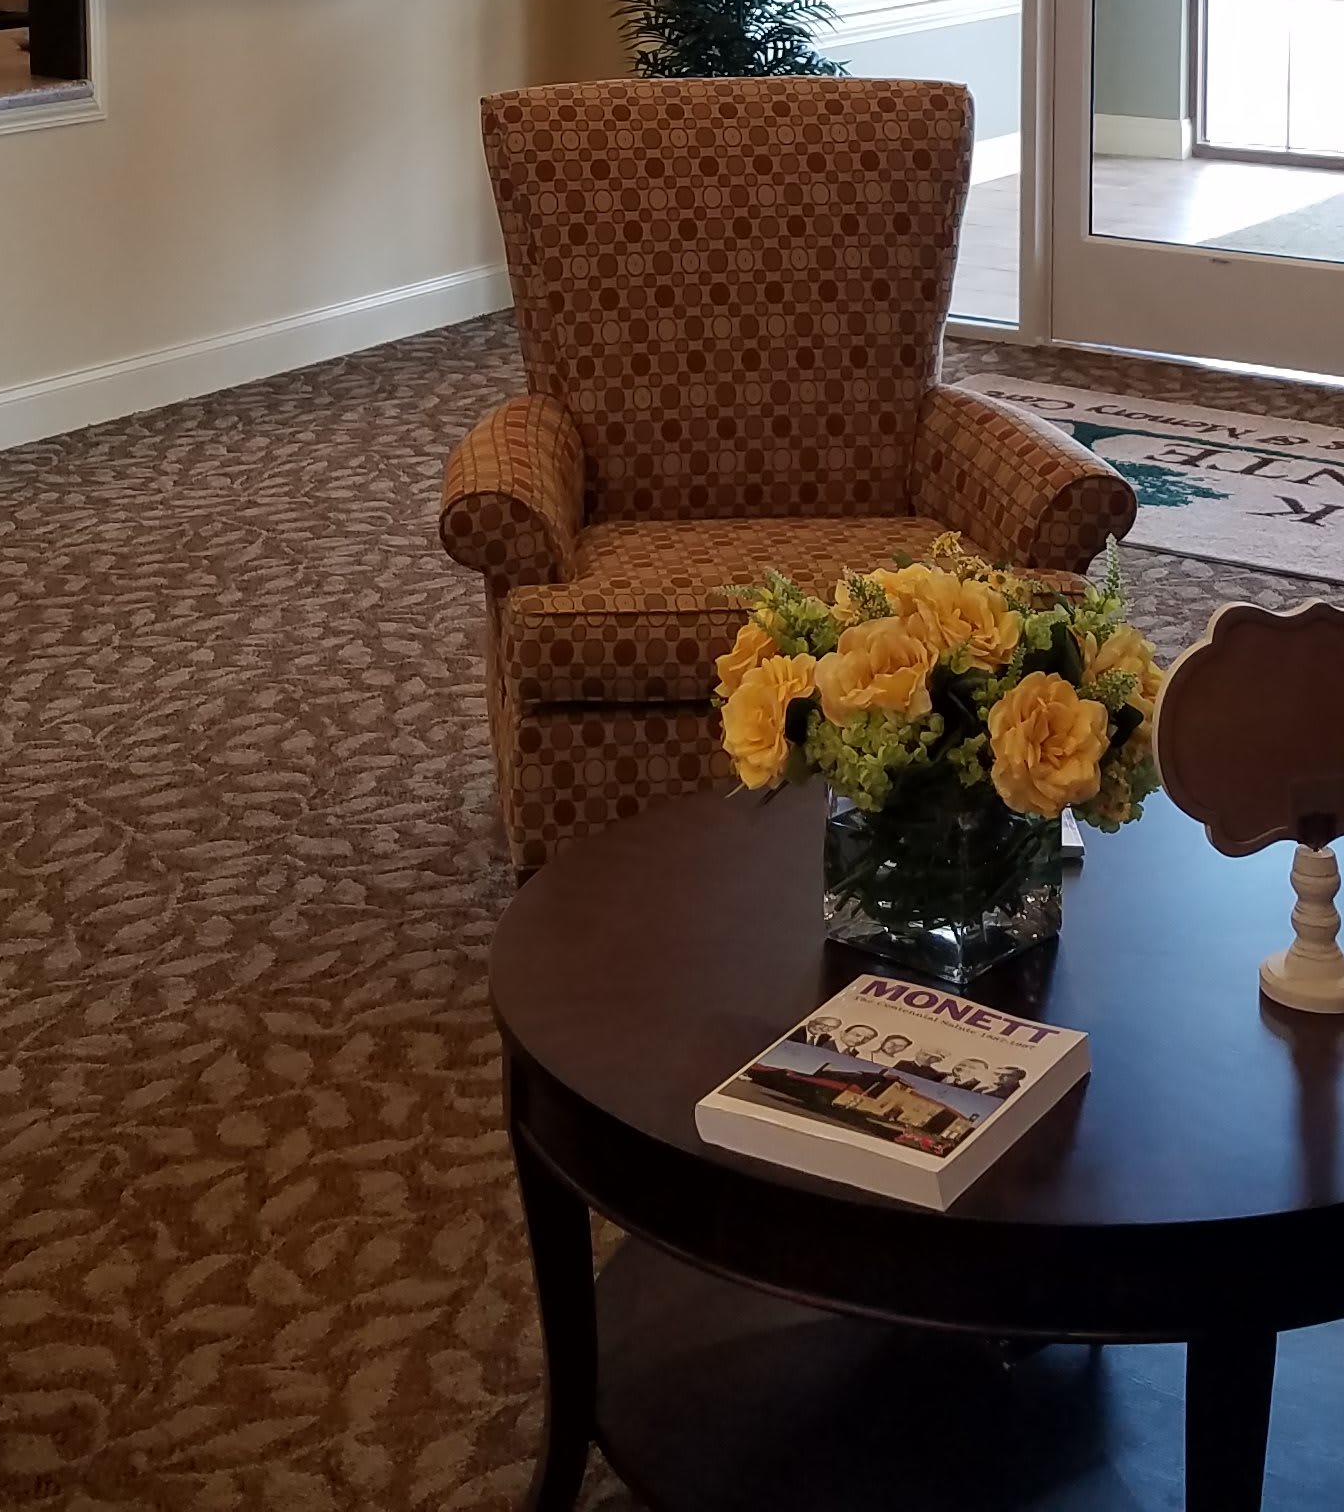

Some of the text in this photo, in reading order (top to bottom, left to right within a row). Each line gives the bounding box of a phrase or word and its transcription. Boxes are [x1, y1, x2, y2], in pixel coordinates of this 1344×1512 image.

[982, 390, 1076, 410] Care
[1085, 404, 1256, 439] Memory
[1257, 435, 1310, 446] &
[860, 980, 1060, 1044] MONETT
